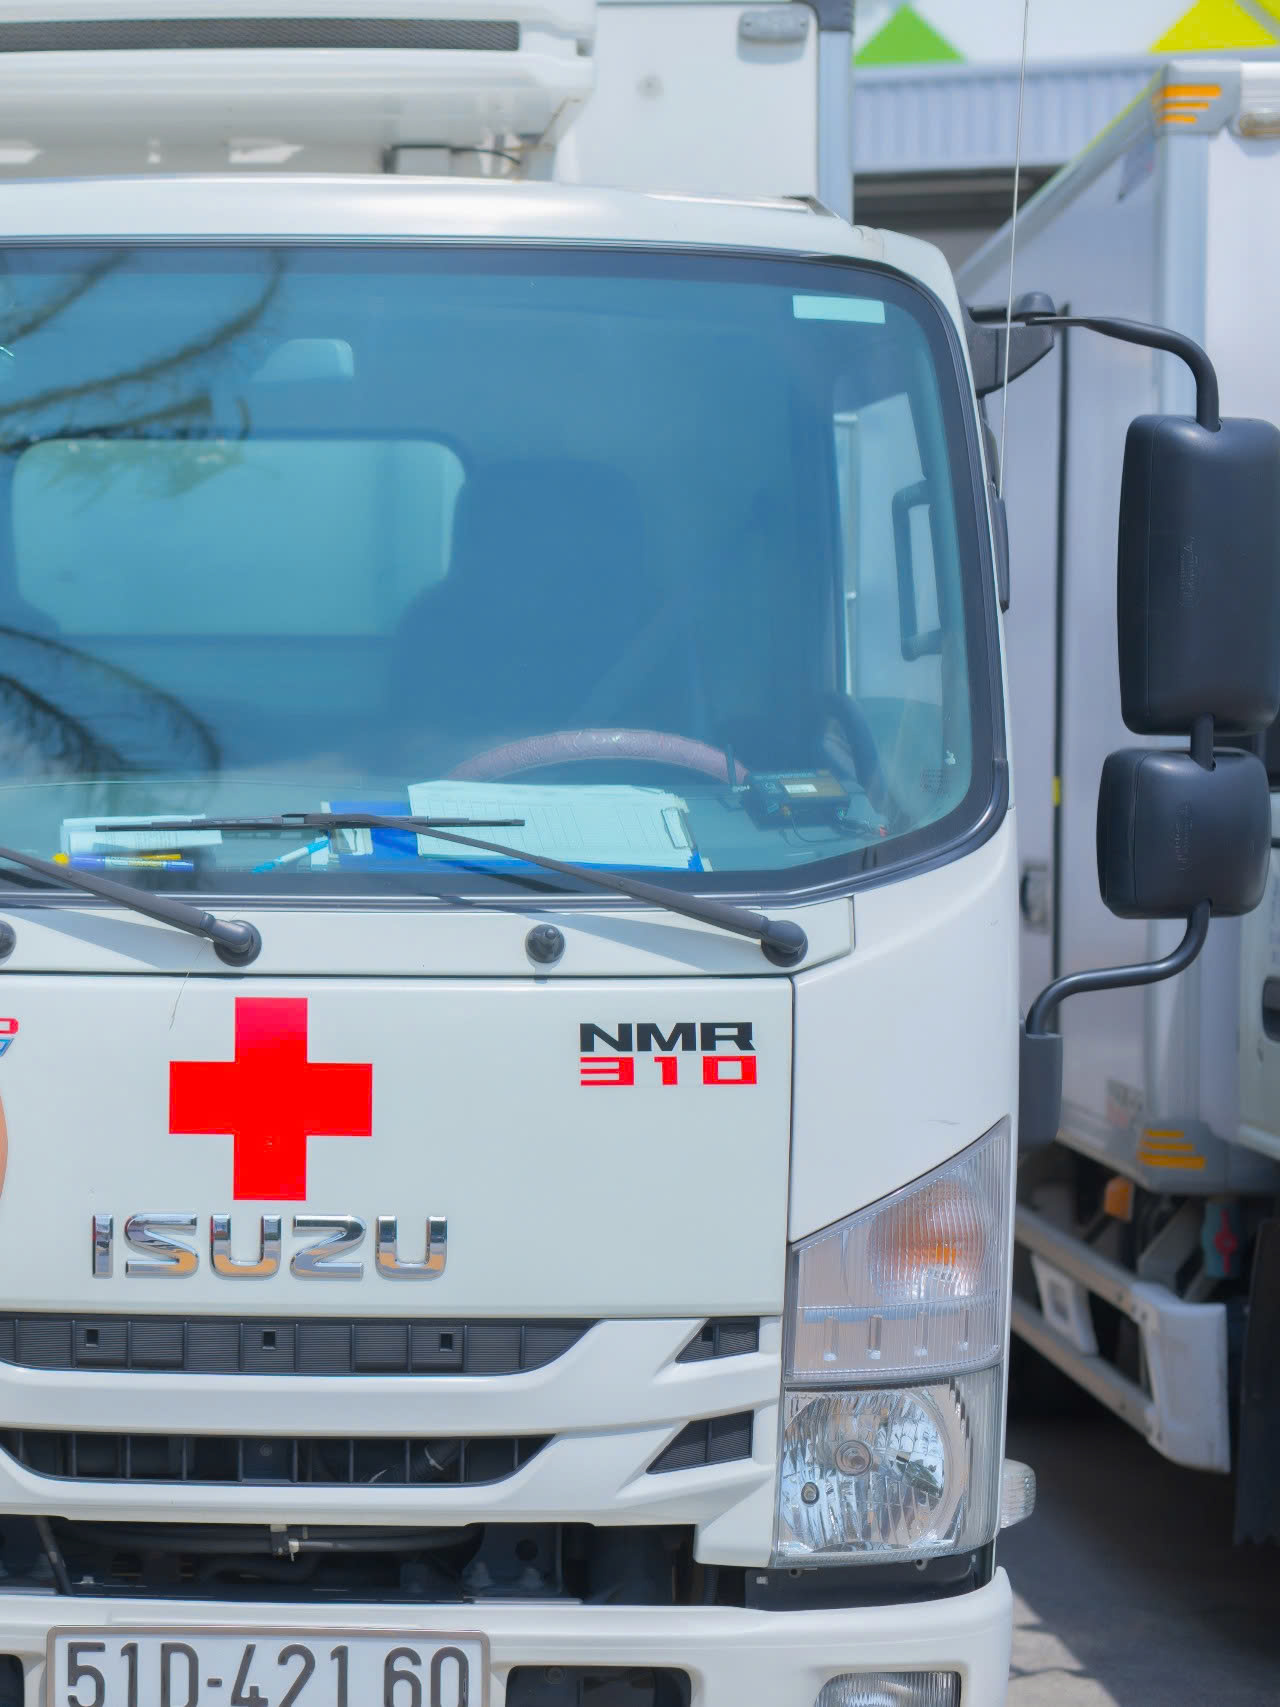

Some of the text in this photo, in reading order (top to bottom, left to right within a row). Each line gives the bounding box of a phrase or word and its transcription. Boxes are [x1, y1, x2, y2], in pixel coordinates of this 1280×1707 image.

[580, 1022, 756, 1052] NMR
[580, 1055, 757, 1086] 310
[92, 1213, 448, 1279] ISUZU
